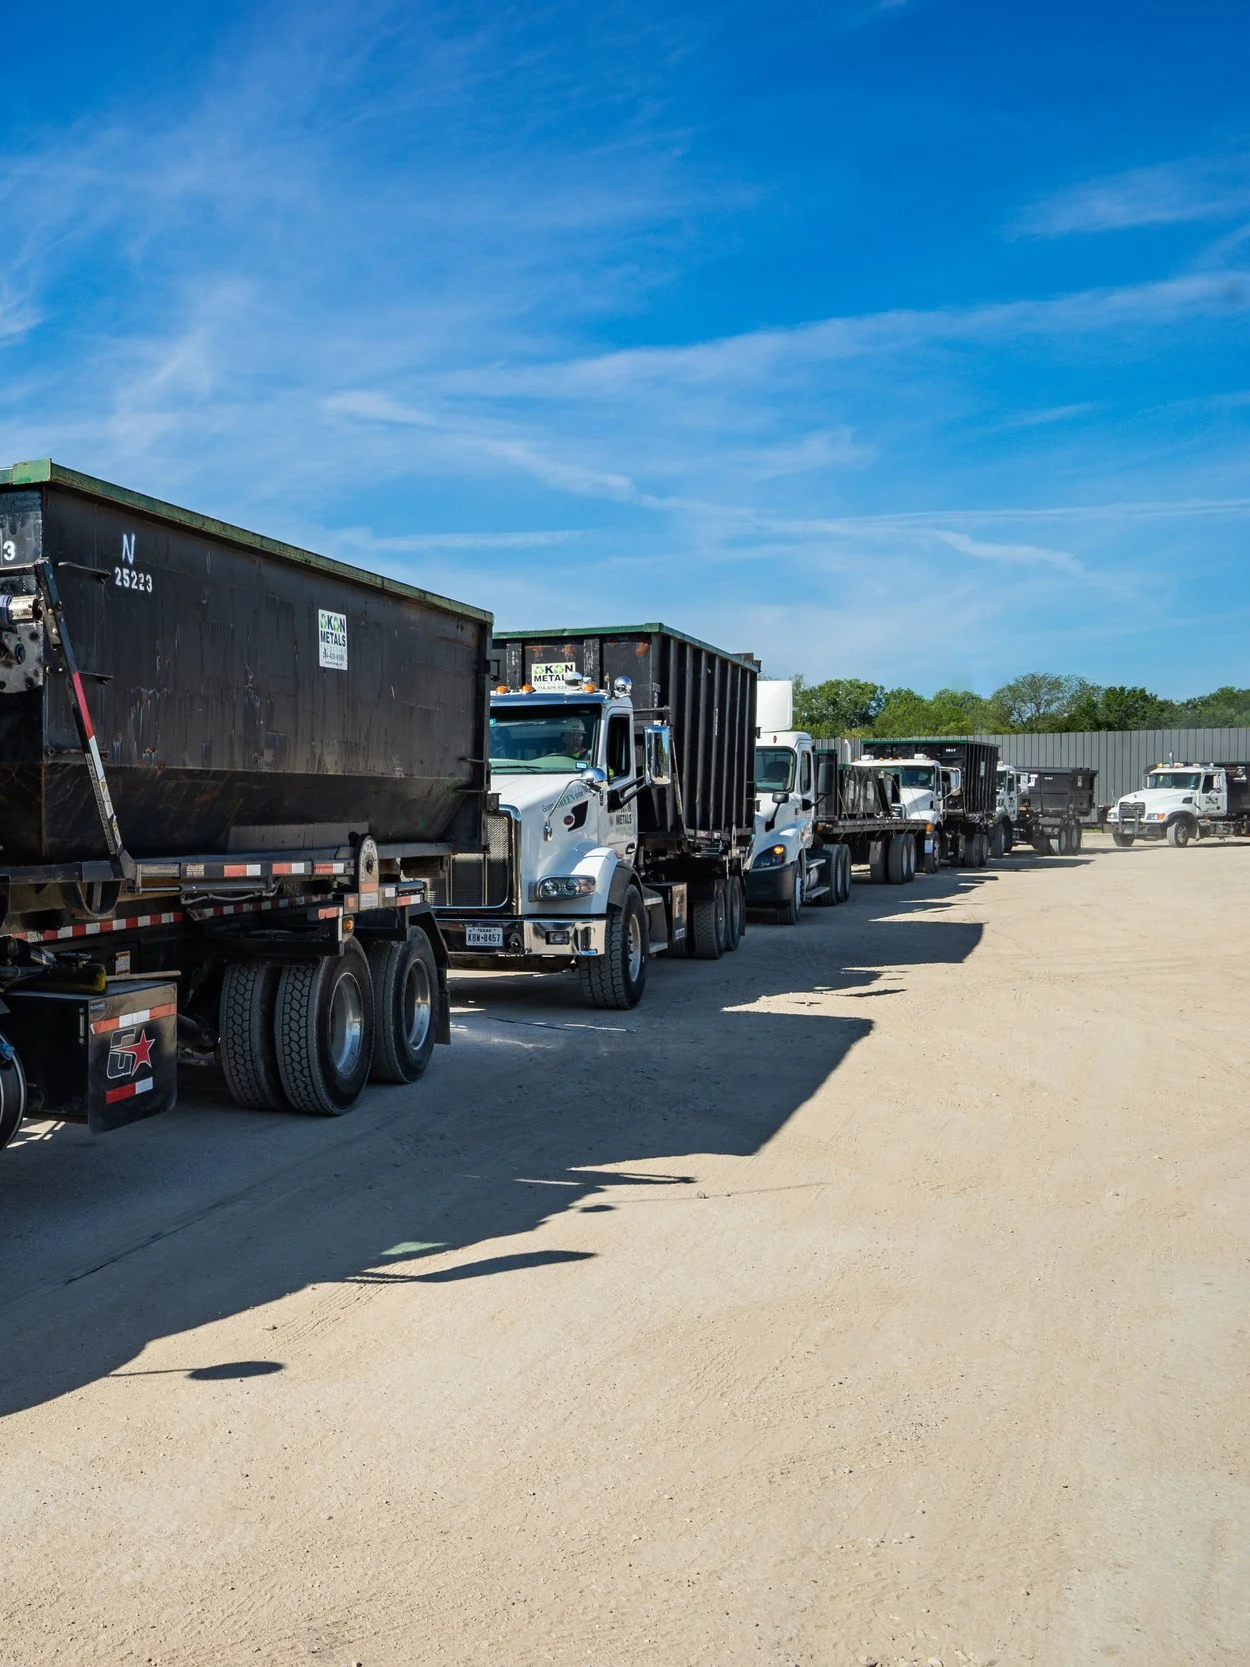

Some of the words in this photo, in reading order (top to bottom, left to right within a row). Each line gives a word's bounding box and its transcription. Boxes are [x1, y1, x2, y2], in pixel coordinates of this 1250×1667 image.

[122, 533, 135, 565] N
[114, 566, 153, 593] 25223
[320, 630, 346, 647] METALS
[534, 674, 566, 682] METAL
